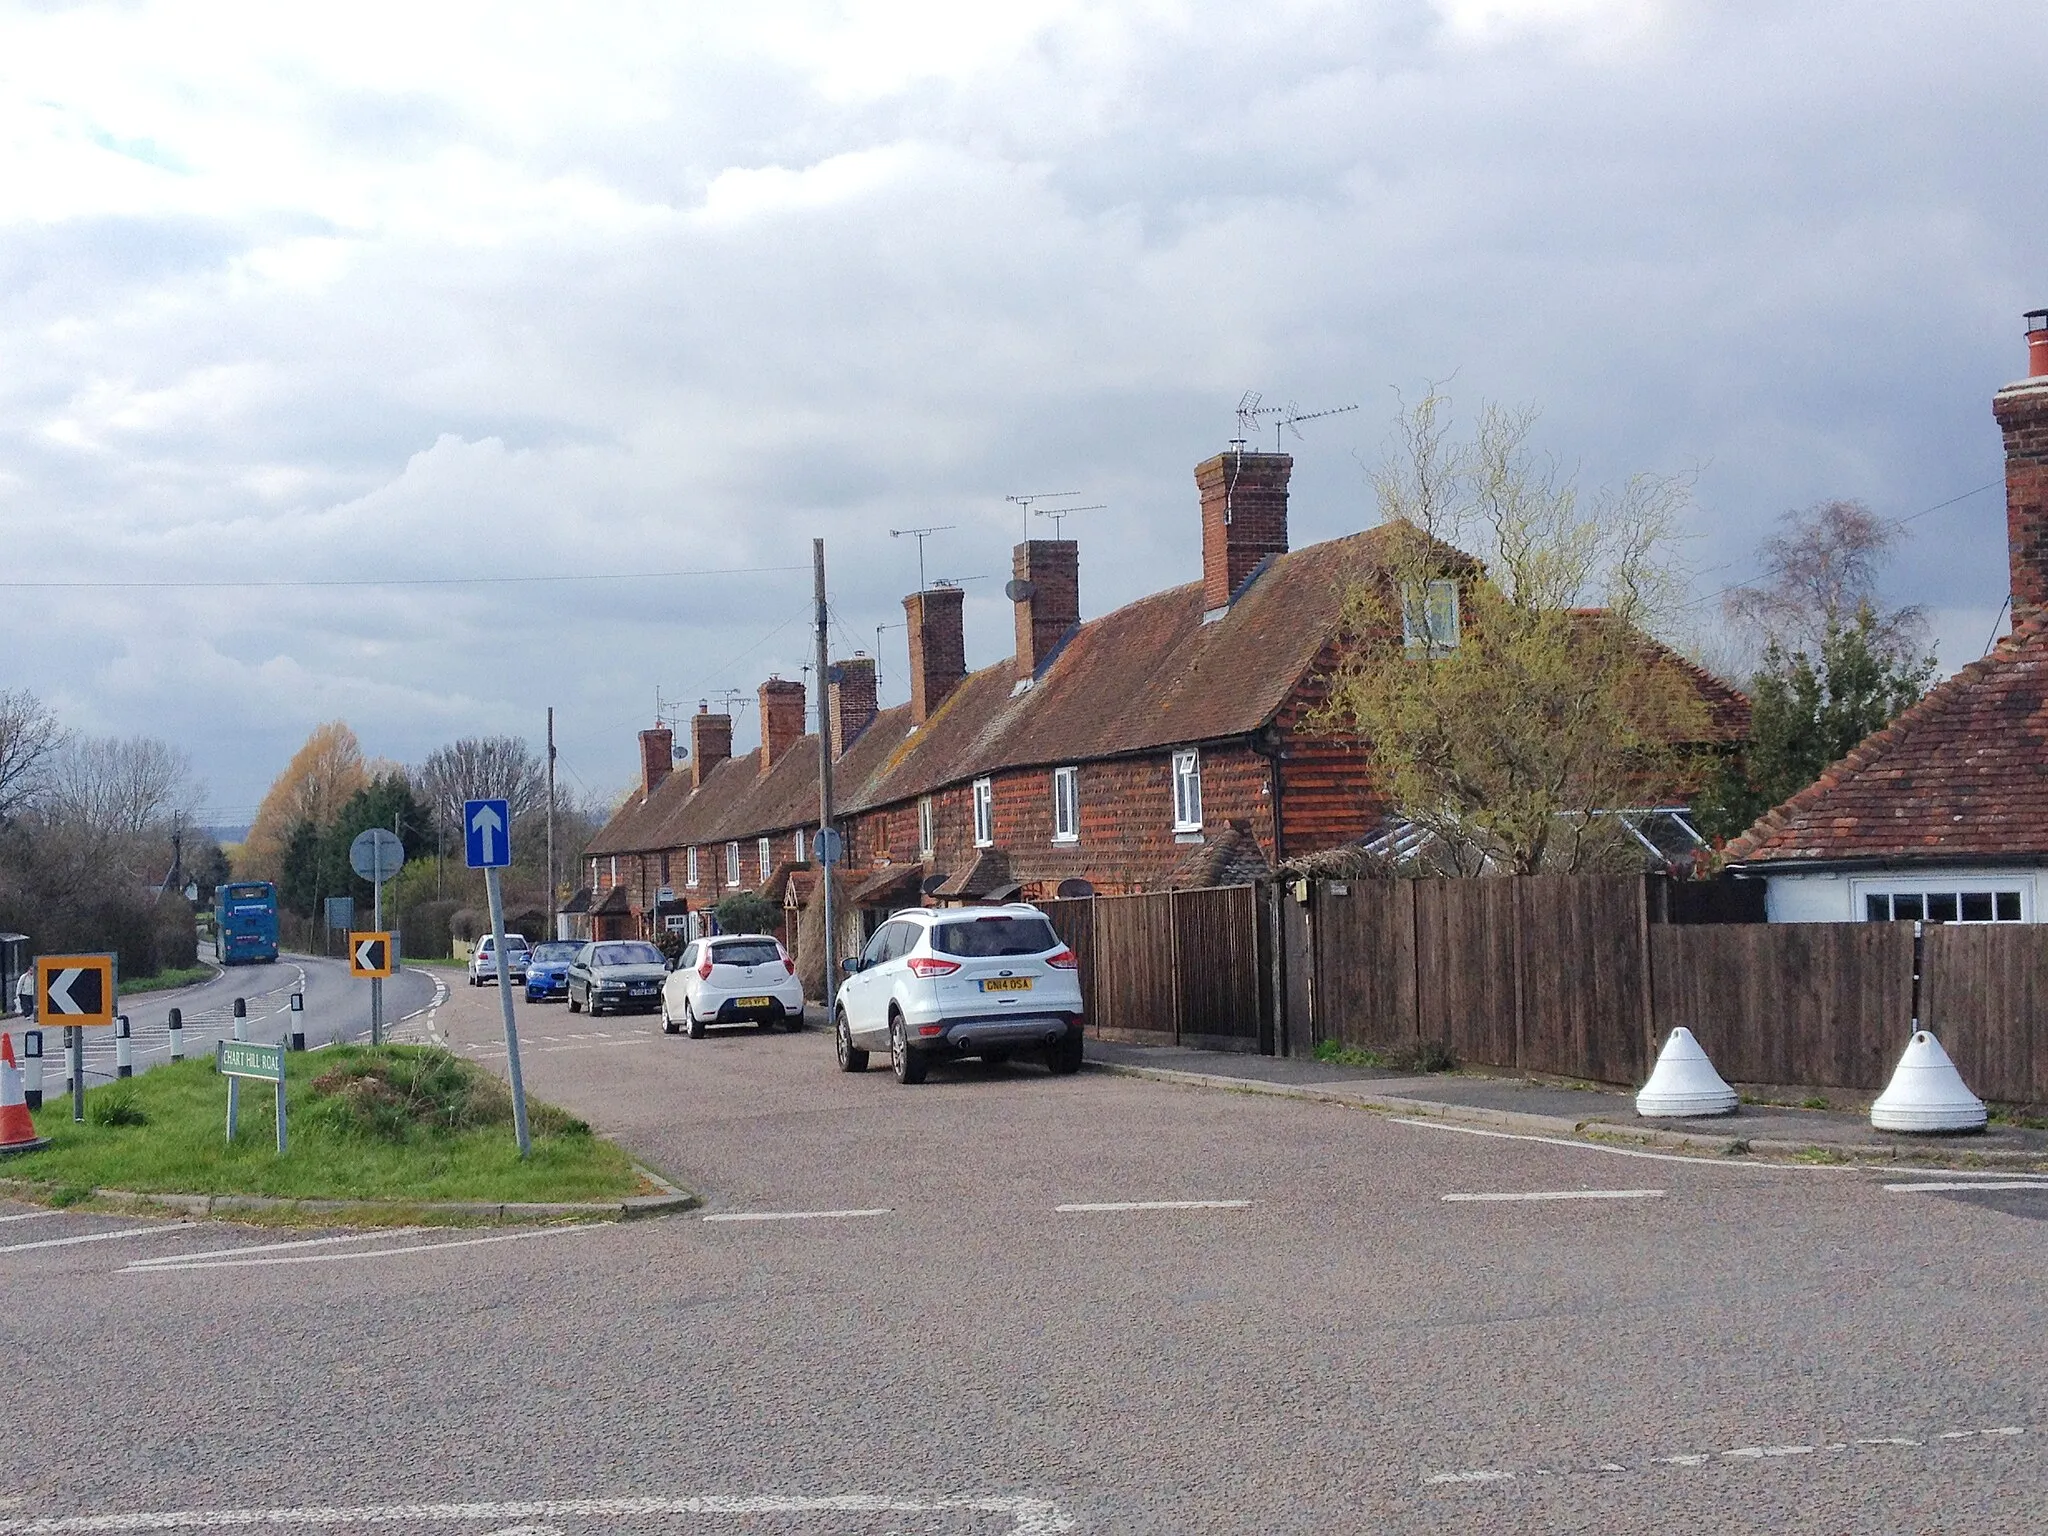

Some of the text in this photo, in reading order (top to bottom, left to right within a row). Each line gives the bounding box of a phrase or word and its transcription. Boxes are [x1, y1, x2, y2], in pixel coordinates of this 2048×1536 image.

[987, 979, 1029, 990] GN14 OSA
[223, 1050, 244, 1066] CHART
[246, 1052, 260, 1068] HILL
